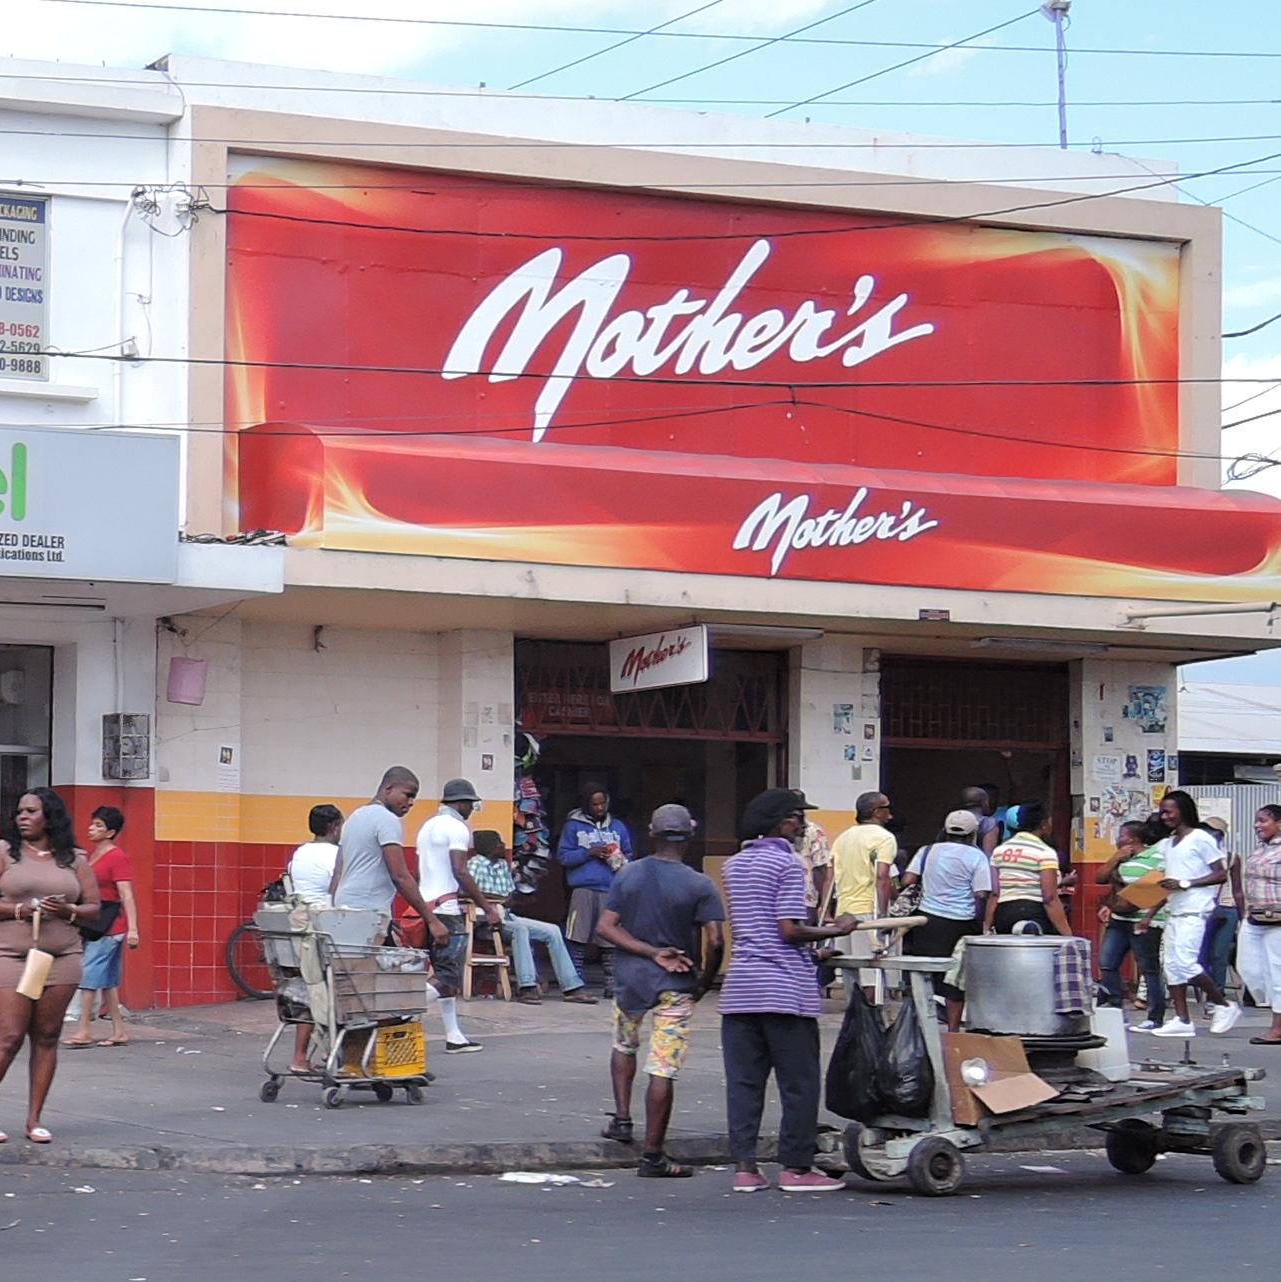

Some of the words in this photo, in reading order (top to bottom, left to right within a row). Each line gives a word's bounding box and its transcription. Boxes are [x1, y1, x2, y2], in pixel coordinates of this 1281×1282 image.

[5, 286, 44, 305] DESIGNS
[441, 239, 935, 443] Mother's
[731, 486, 940, 576] Mother's
[22, 534, 65, 549] DEALER
[47, 550, 66, 563] Ltd.
